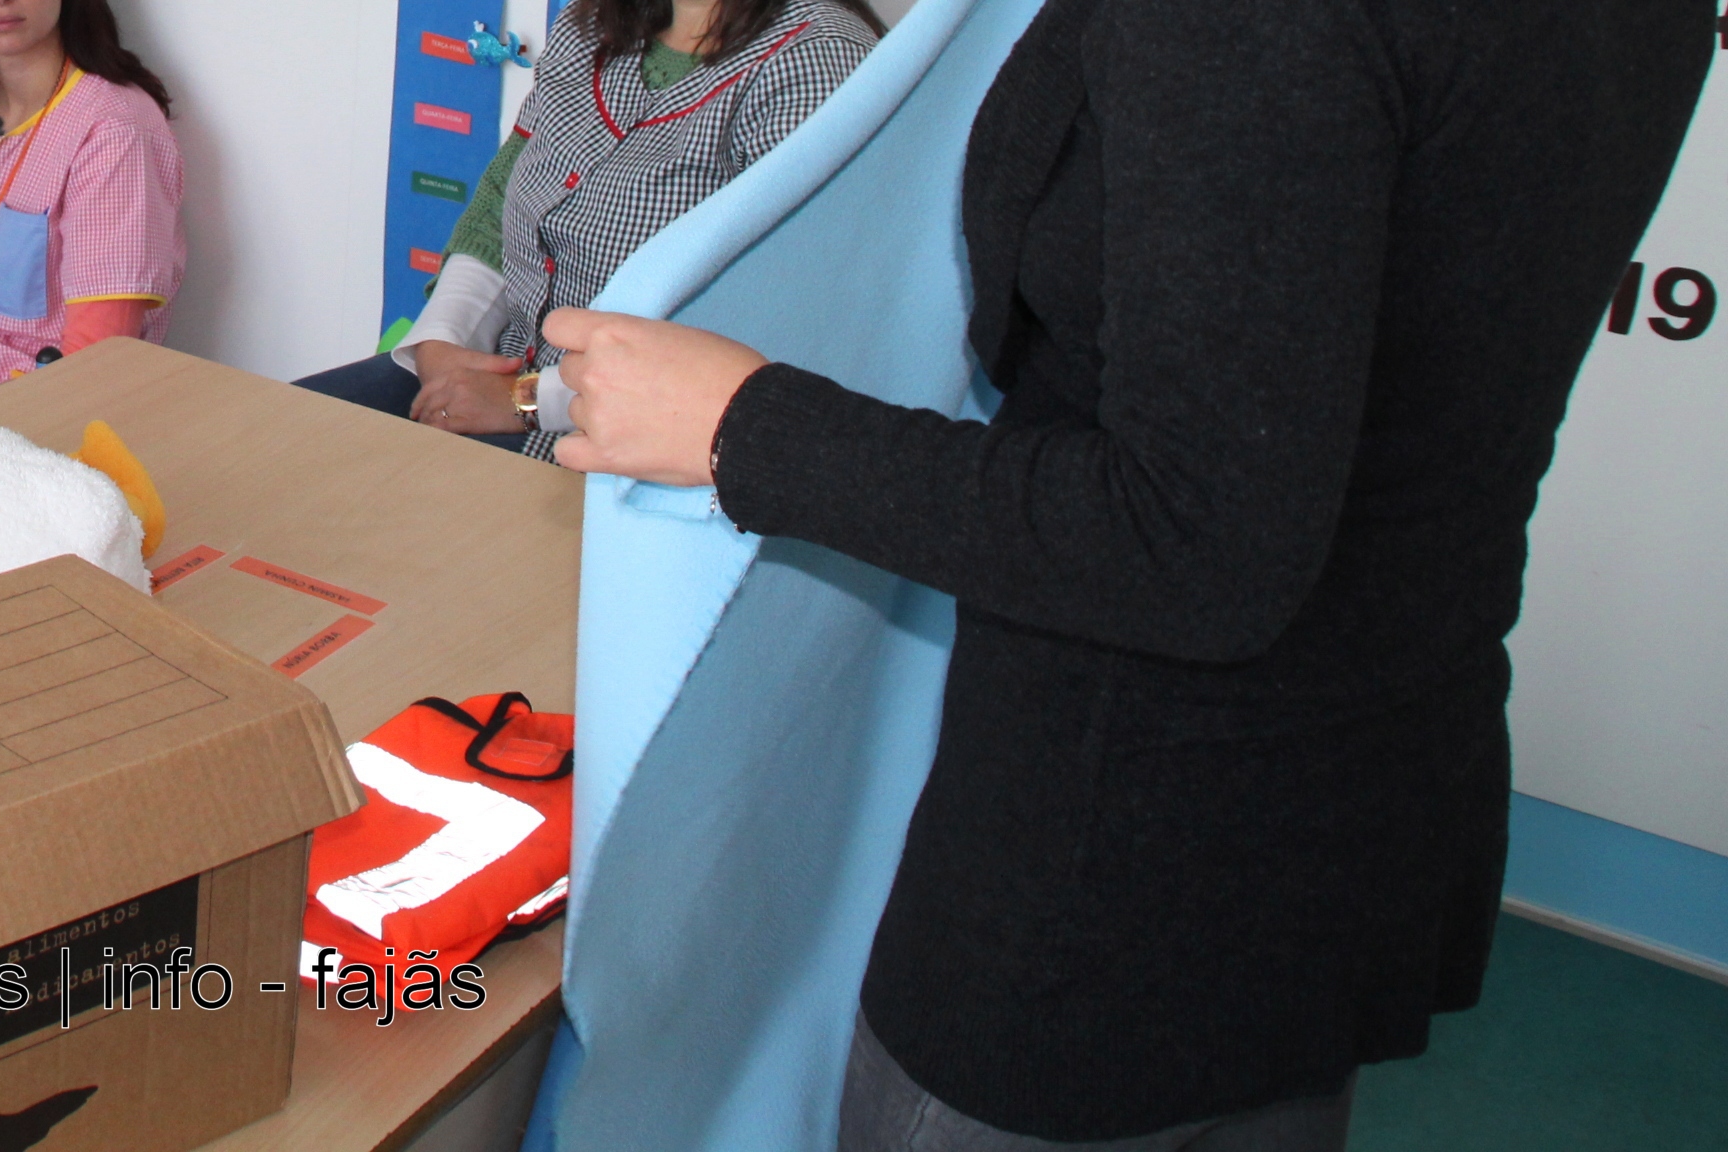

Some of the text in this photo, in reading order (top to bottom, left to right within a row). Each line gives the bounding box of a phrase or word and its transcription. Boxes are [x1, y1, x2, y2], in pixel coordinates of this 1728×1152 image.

[1607, 260, 1719, 342] 19
[4, 928, 182, 1014] dicamentos
[6, 899, 141, 963] alimentos
